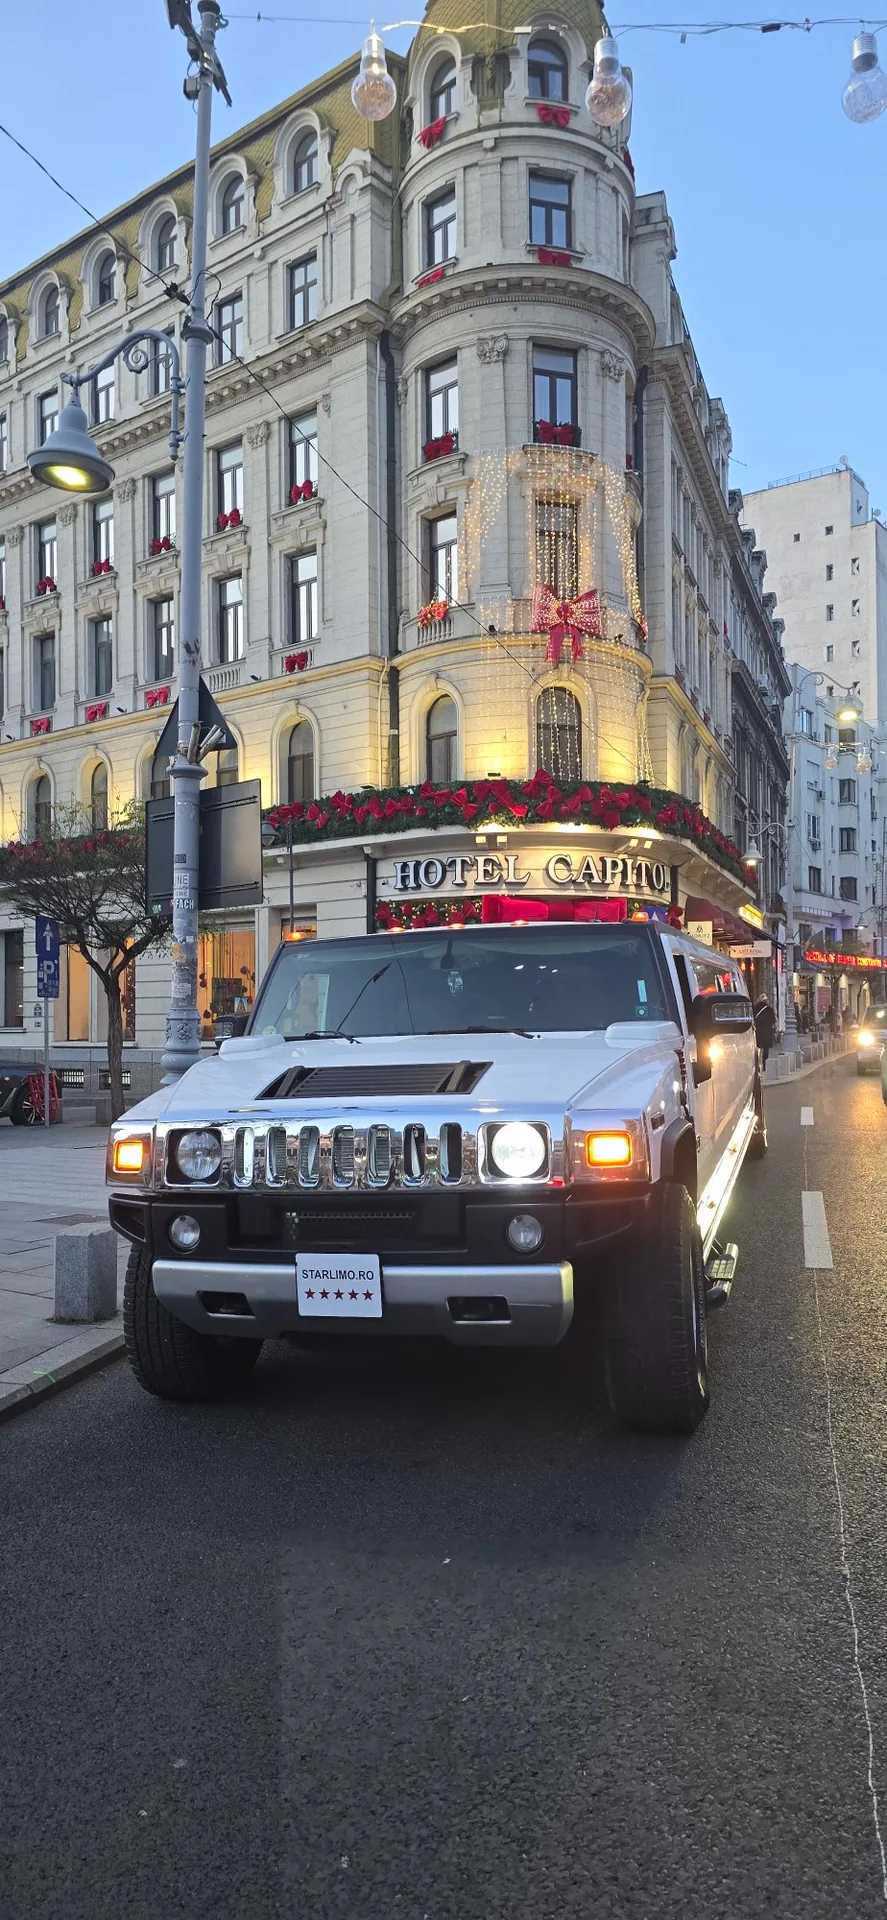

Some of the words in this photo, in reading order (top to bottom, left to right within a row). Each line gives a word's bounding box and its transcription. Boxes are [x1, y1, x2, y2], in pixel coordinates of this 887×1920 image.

[393, 854, 531, 890] HOTEL
[547, 853, 670, 892] CAPITOL
[43, 960, 55, 984] P
[301, 1269, 375, 1281] STARLIMO.RO
